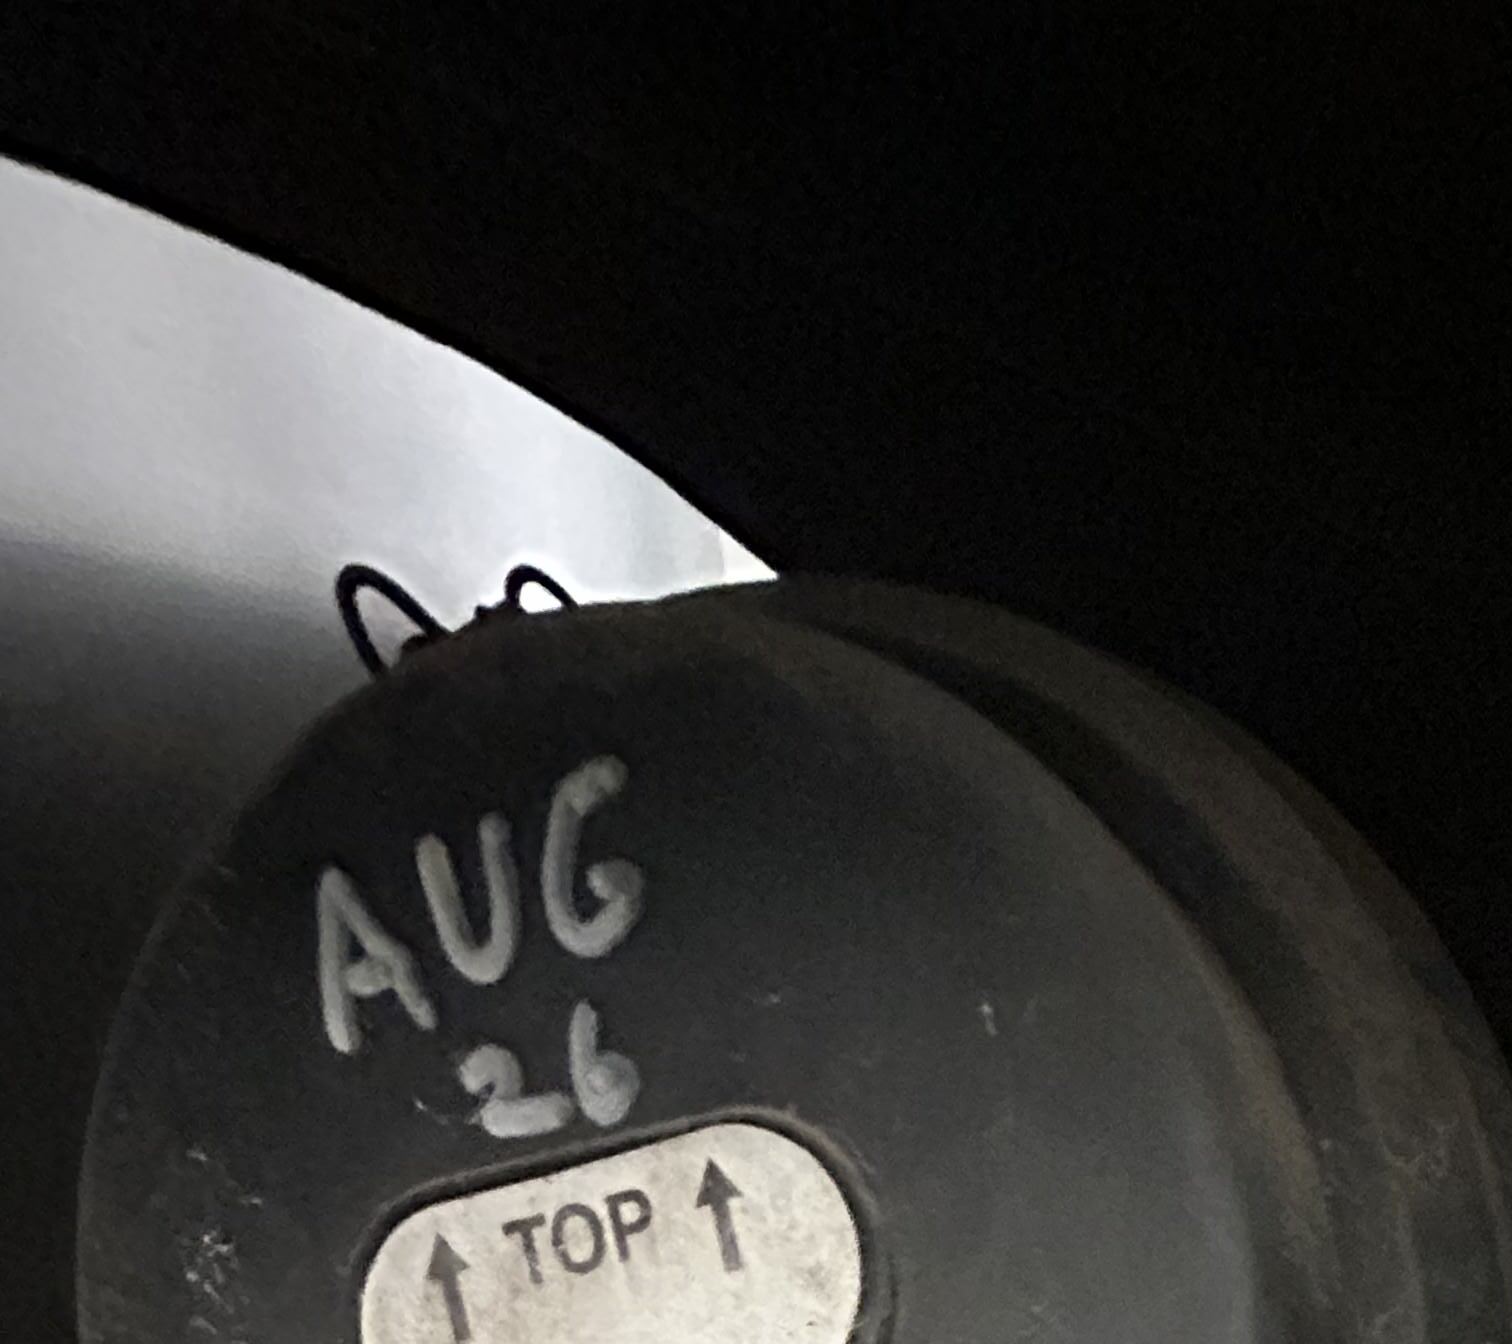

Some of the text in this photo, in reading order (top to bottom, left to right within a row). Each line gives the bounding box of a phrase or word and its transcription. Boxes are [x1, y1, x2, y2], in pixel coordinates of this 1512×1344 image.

[314, 752, 645, 1056] AUG
[456, 1001, 641, 1140] 26
[502, 1187, 654, 1285] TOP
